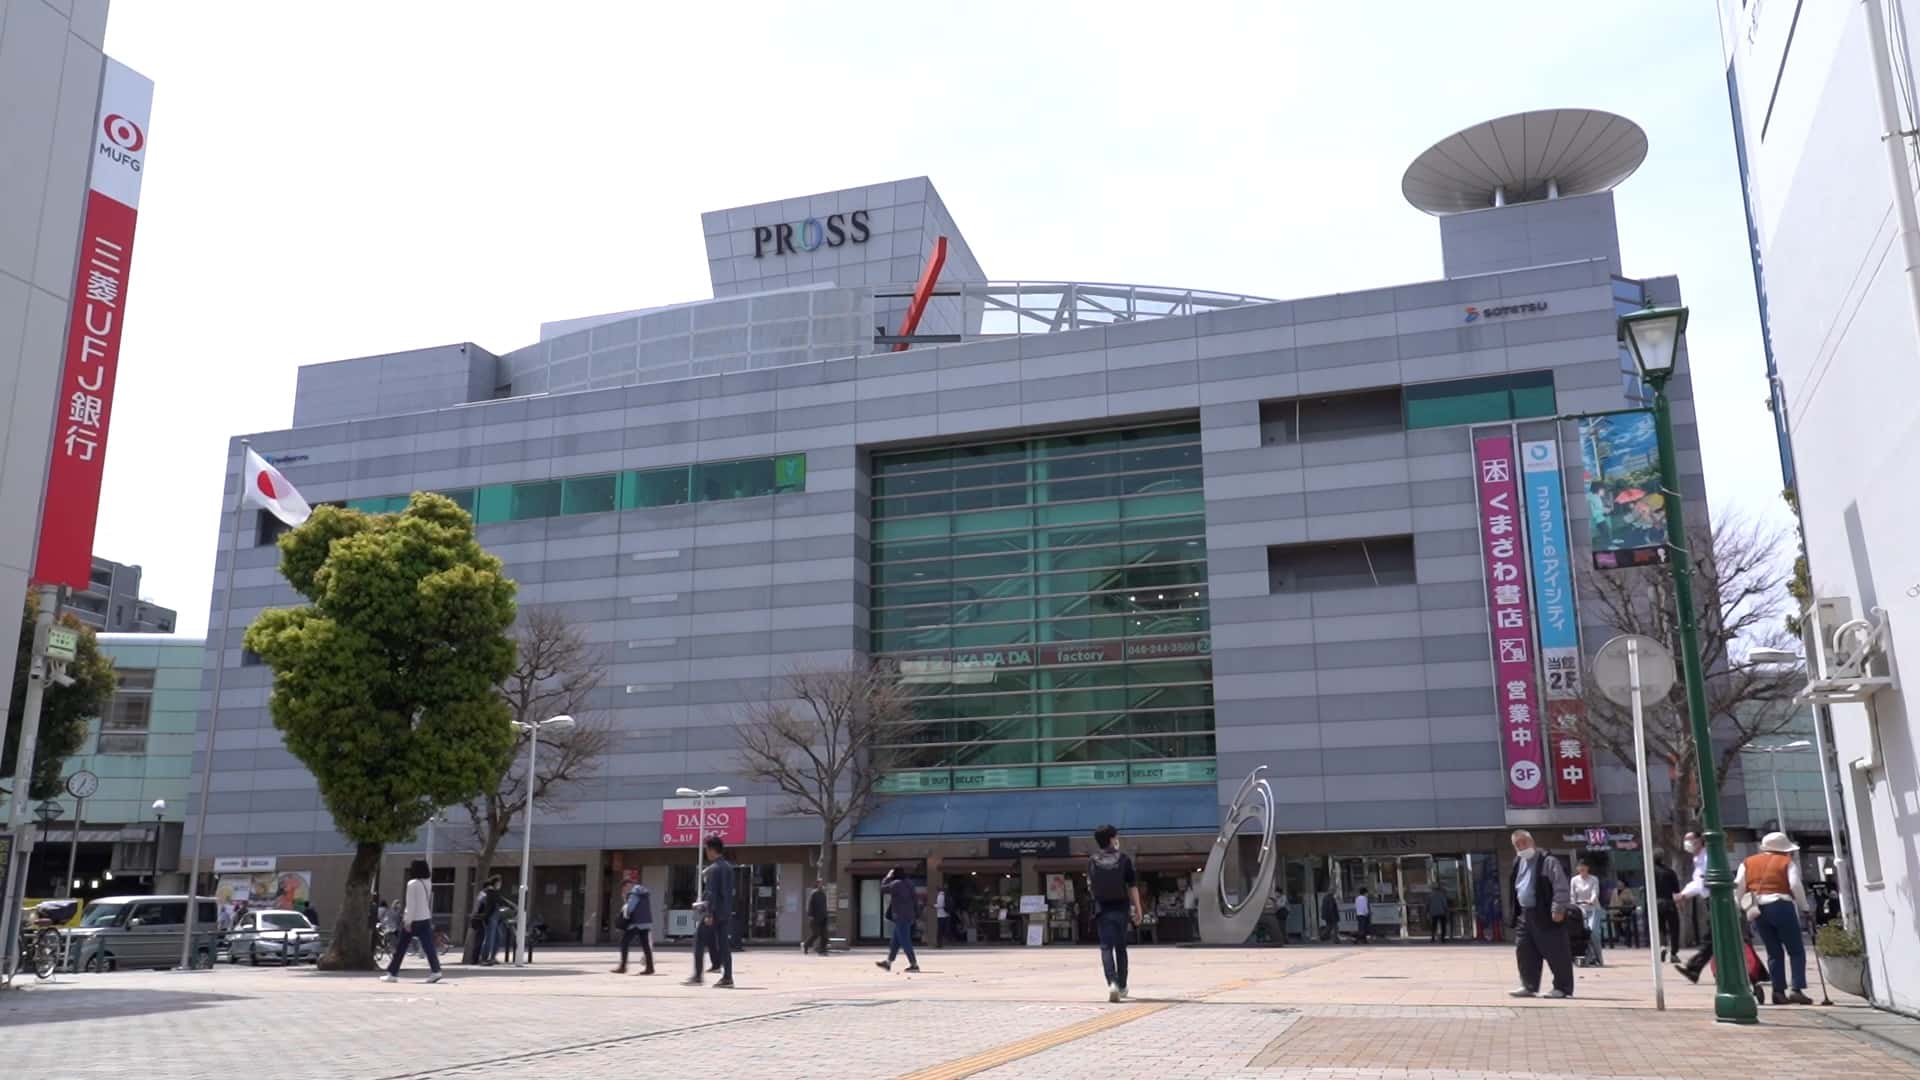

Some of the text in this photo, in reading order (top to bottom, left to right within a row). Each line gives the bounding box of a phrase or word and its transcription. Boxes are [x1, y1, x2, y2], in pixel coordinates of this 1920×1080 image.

[99, 143, 141, 172] MUFG
[752, 210, 870, 258] PROSS
[1483, 302, 1548, 317] SOTETSU
[65, 237, 122, 461] 三菱UFJ銀行
[1489, 492, 1523, 629] くまざわ書店
[1057, 651, 1104, 663] factory
[1547, 656, 1576, 671] 当館
[1549, 672, 1577, 689] 2F
[1507, 680, 1532, 747] 営業中
[1515, 768, 1536, 781] 3F
